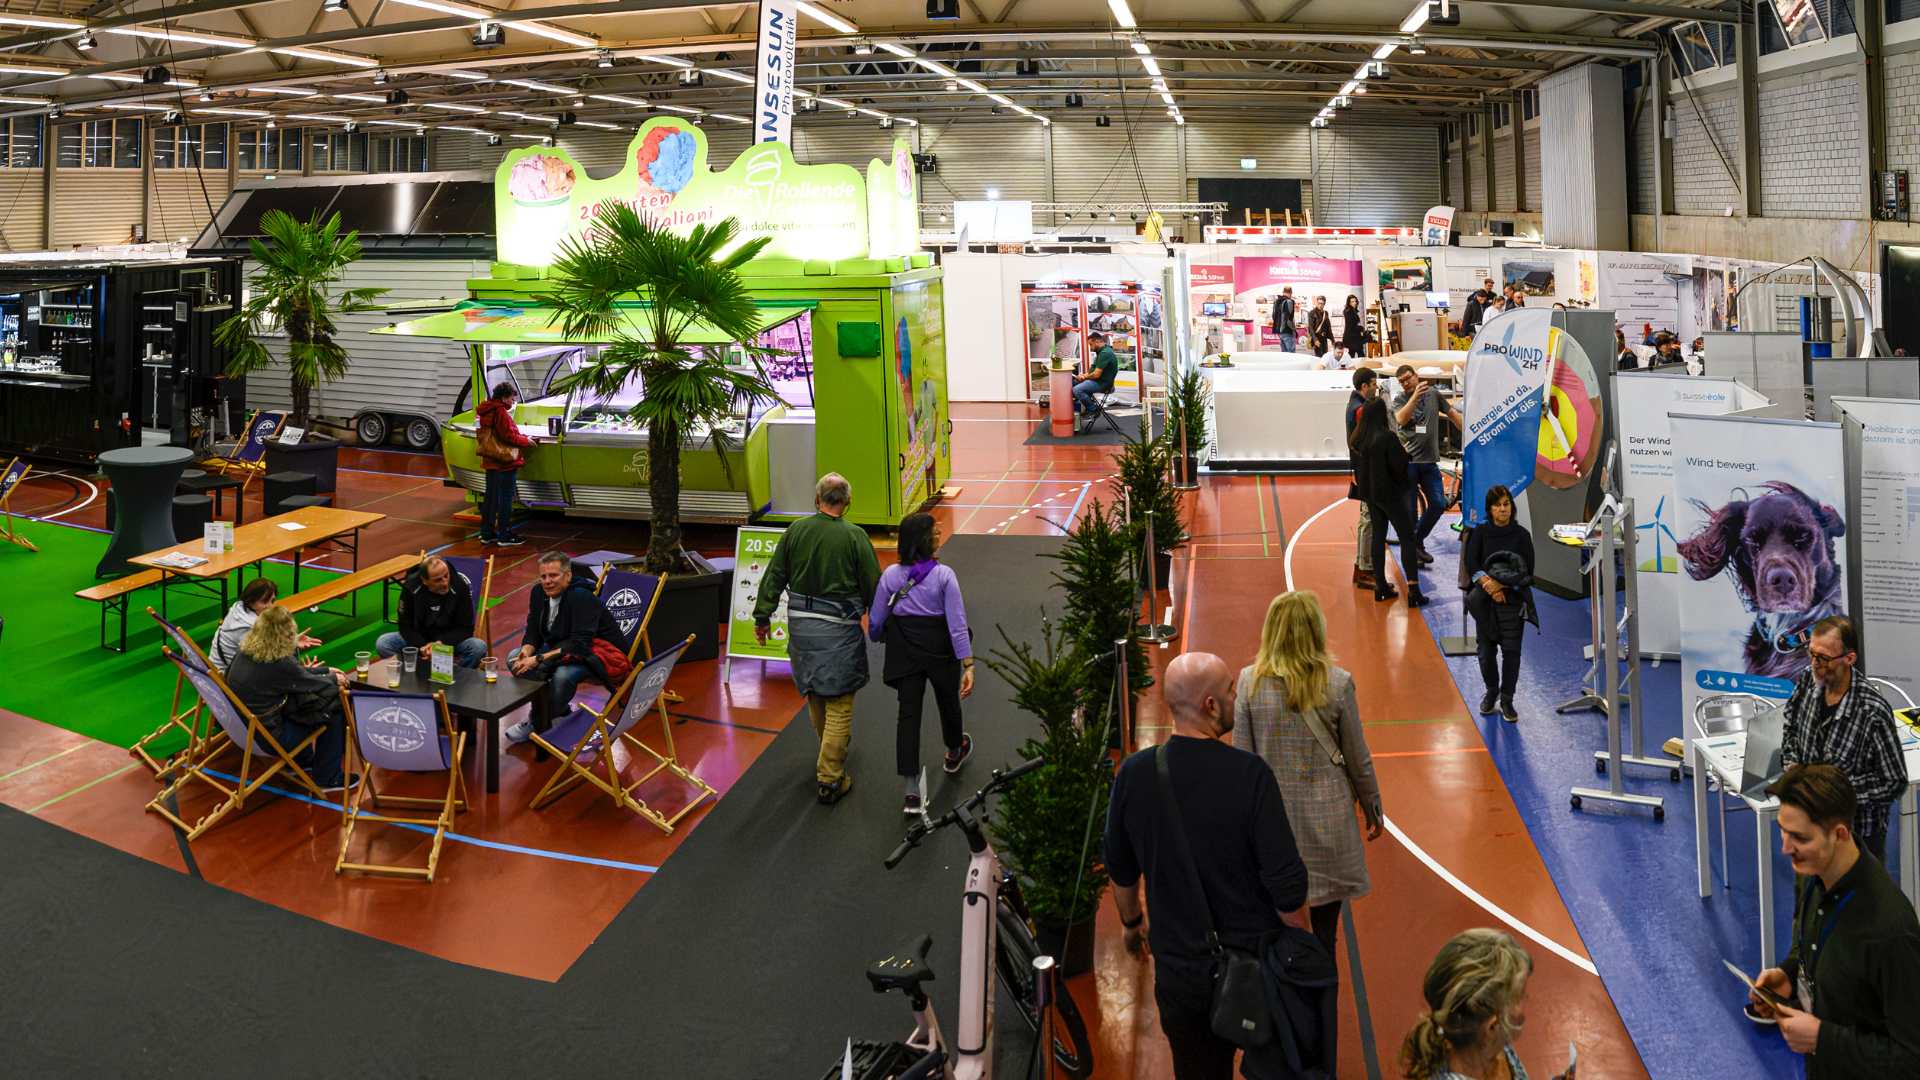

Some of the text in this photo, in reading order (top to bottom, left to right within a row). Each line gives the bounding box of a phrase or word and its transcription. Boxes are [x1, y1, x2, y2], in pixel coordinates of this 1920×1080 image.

[781, 17, 795, 116] Photovoltaik
[1521, 359, 1538, 371] ZH
[1469, 403, 1504, 435] Energie
[1502, 394, 1516, 407] vo
[1478, 423, 1507, 447] Strom
[1504, 408, 1520, 425] für
[1629, 436, 1671, 446] Der Wind
[1629, 448, 1673, 457] nutzen wi
[1686, 457, 1760, 473] Wind bewegt.
[745, 538, 762, 553] 20
